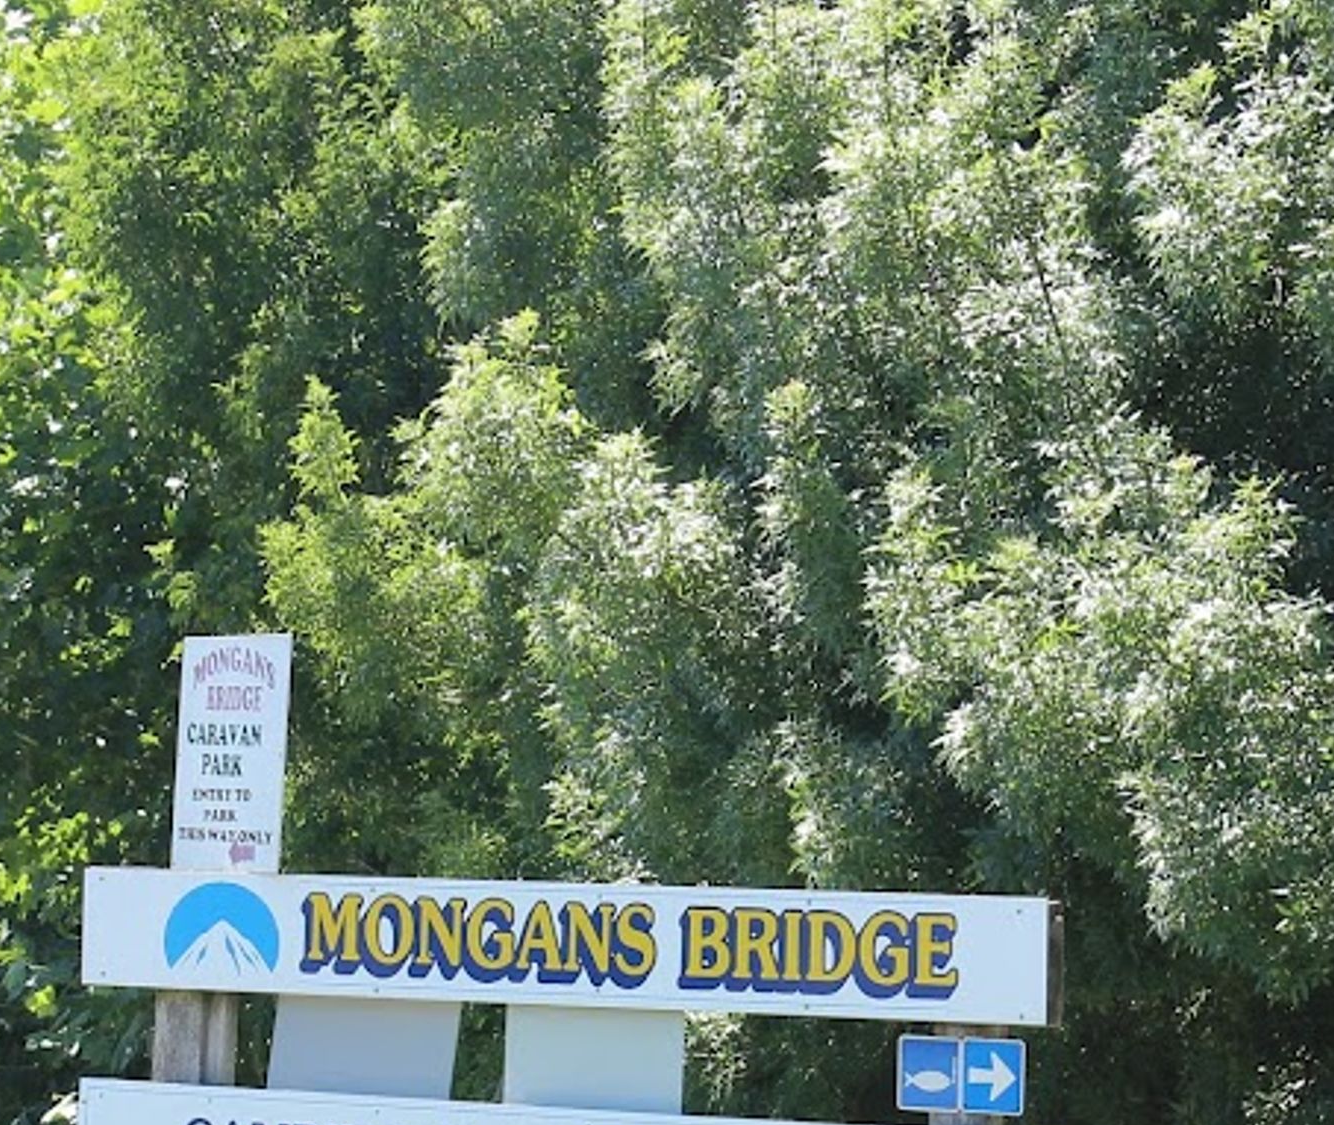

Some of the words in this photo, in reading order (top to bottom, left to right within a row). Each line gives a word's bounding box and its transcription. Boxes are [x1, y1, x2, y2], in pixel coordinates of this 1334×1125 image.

[205, 686, 263, 711] BRIDGE
[187, 723, 263, 746] CARAVAN
[201, 753, 243, 776] PARK
[192, 788, 231, 802] ENTRY
[235, 788, 253, 802] TO
[203, 809, 237, 822] PARK
[237, 829, 272, 846] ONLY
[299, 891, 656, 989] MONGANS
[677, 905, 959, 999] BRIDGE
